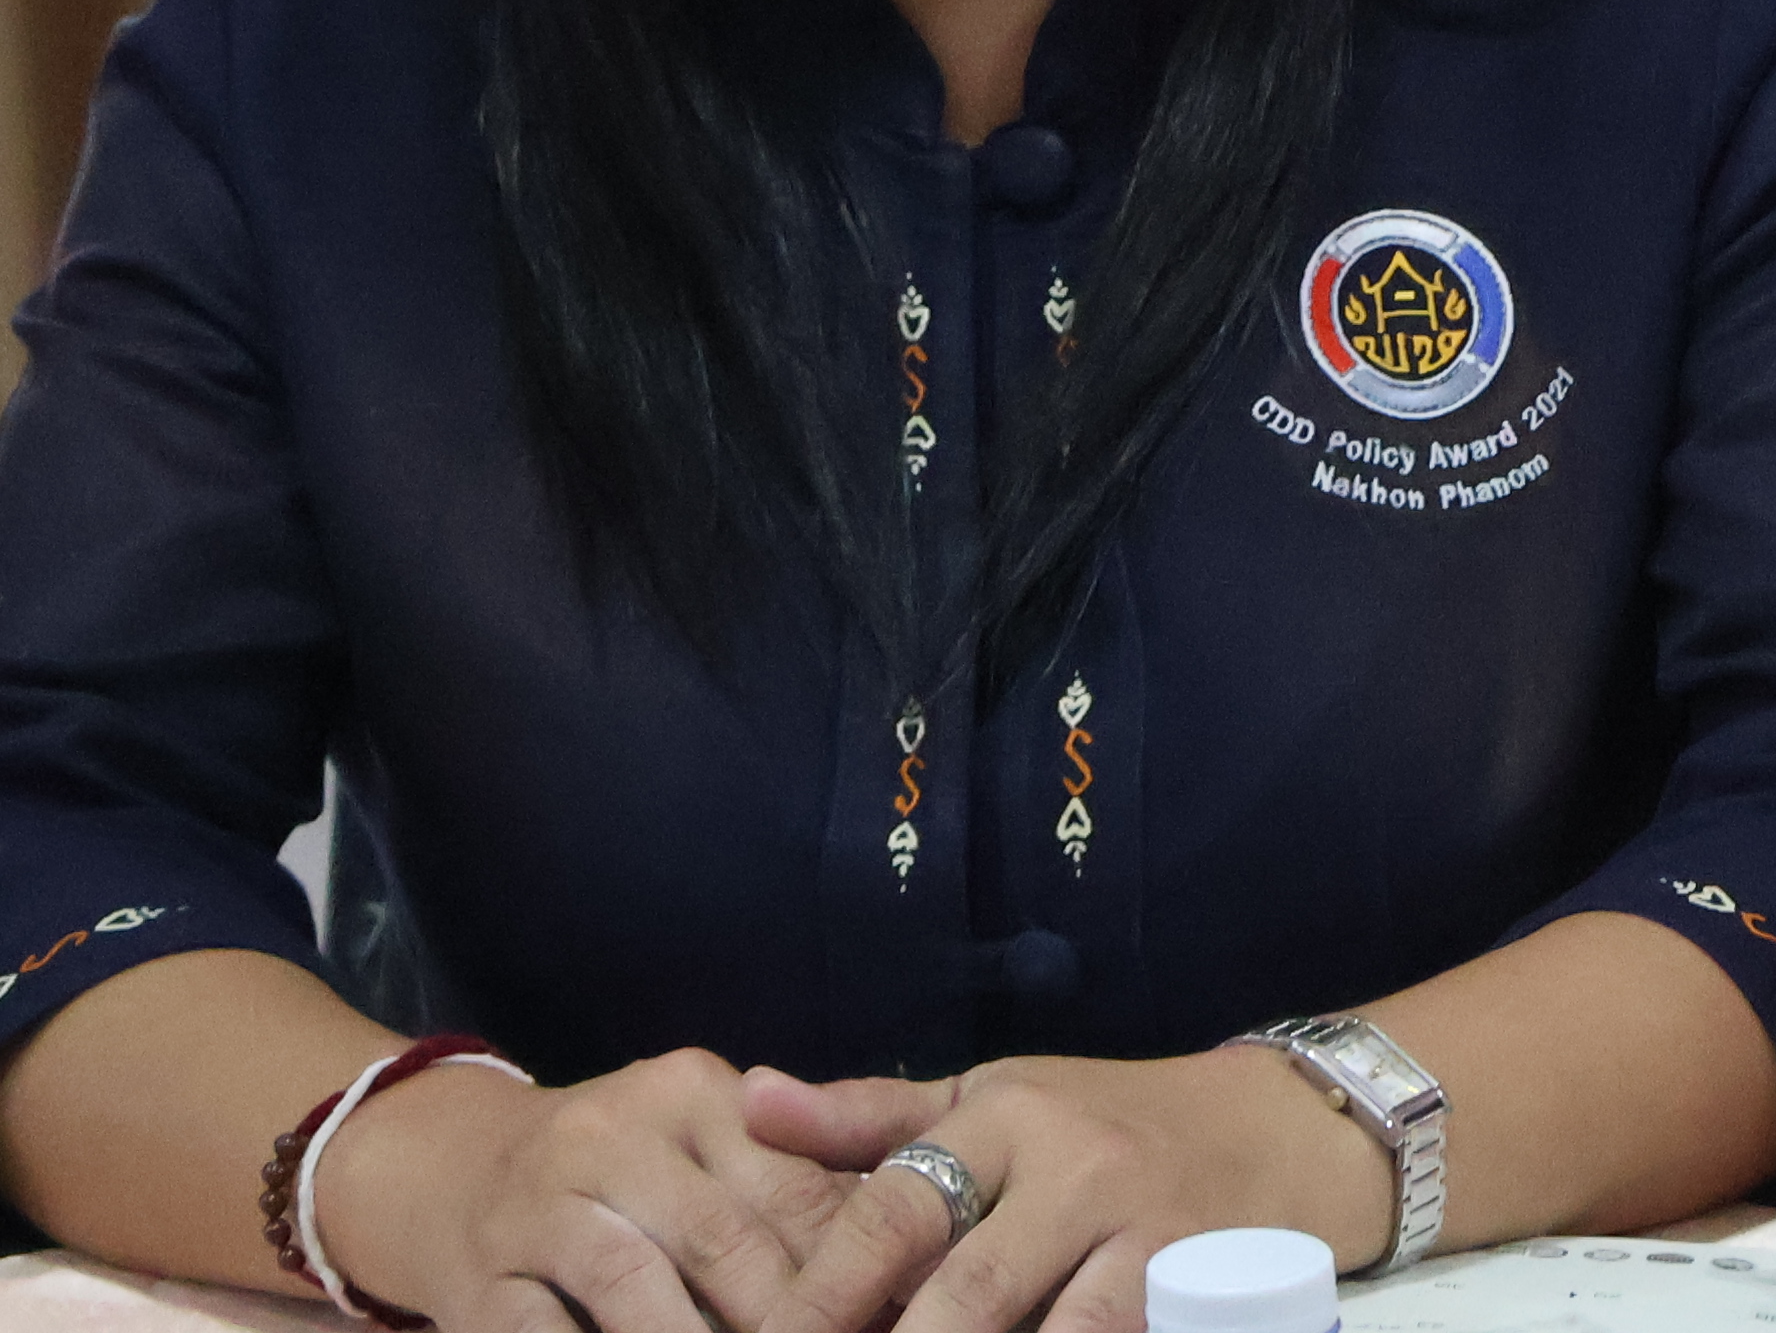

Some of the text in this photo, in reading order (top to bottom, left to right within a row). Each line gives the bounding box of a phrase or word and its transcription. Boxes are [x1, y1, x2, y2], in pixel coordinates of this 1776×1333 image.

[1251, 366, 1576, 473] CDD Policy Award 2021
[1312, 453, 1551, 510] Nakhon Phanom
